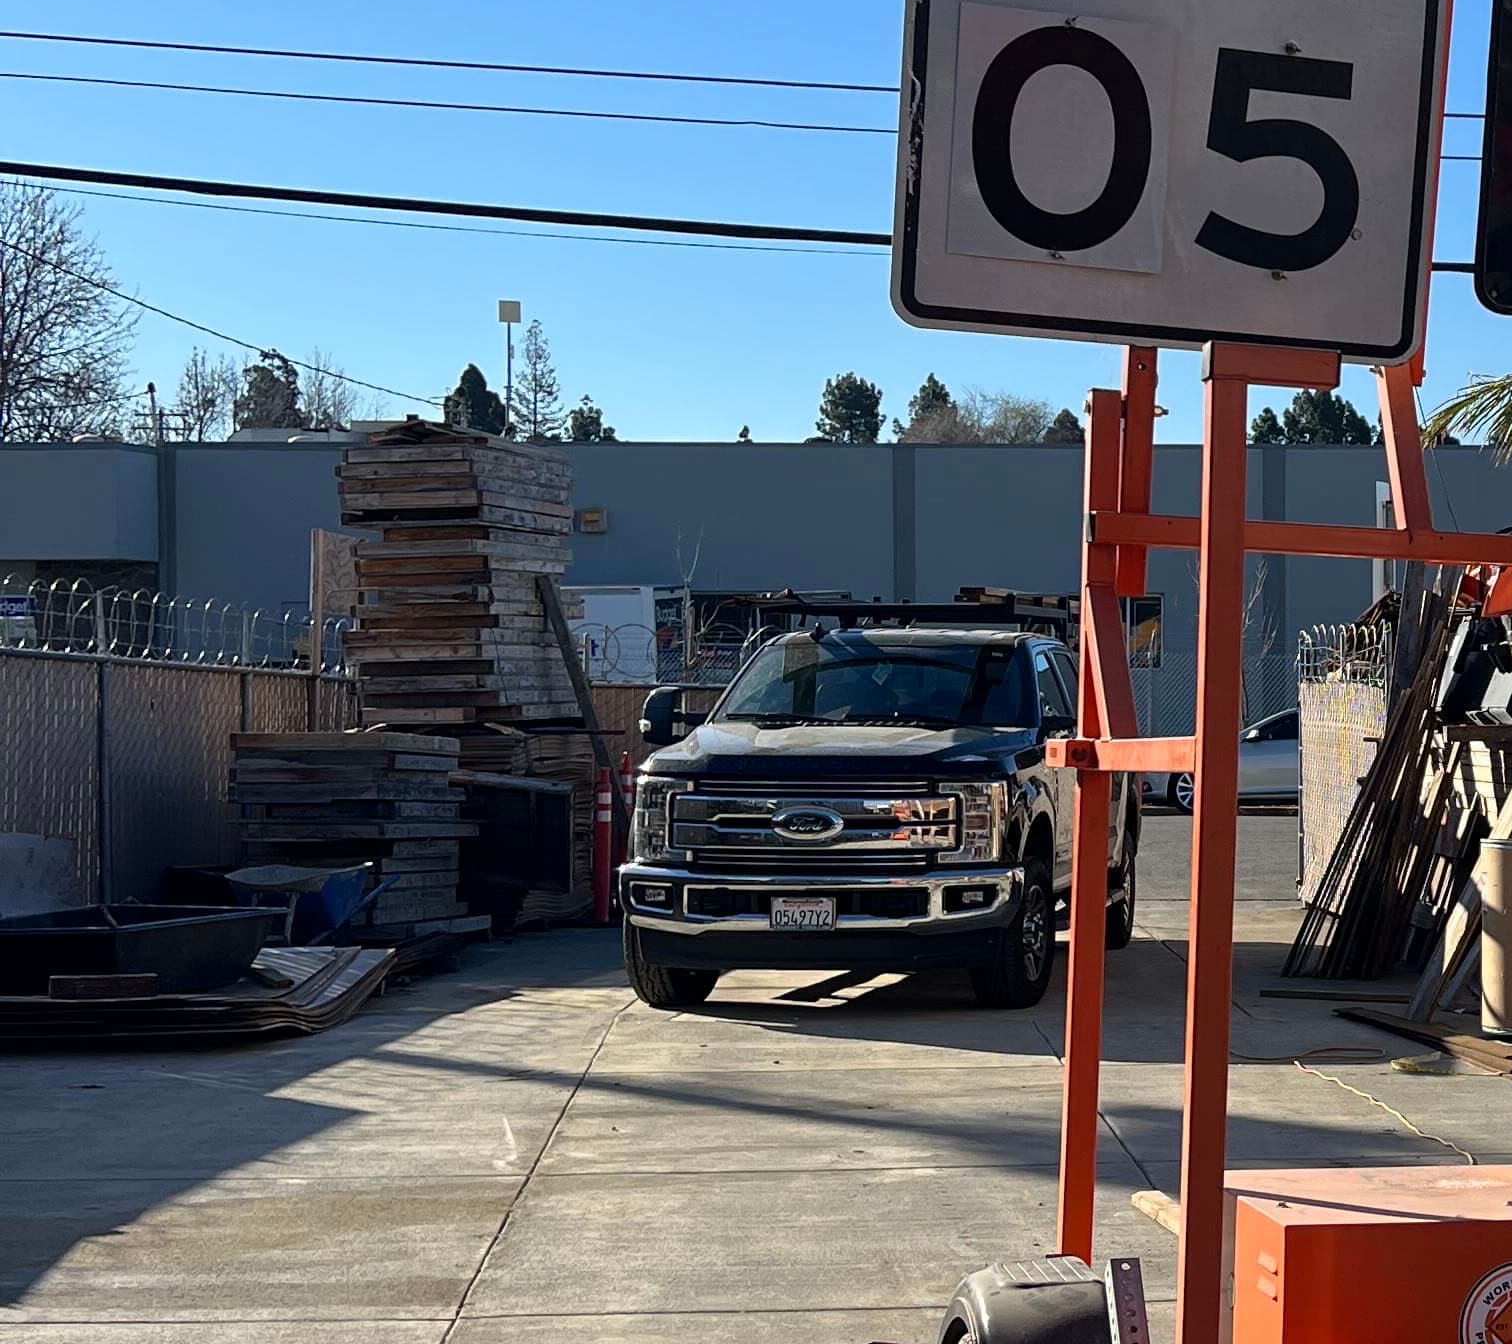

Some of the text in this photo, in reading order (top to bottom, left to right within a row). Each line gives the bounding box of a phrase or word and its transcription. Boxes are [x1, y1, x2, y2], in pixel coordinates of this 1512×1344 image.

[971, 25, 1361, 272] 05
[789, 816, 824, 831] Ford
[775, 910, 830, 926] 05497Y2
